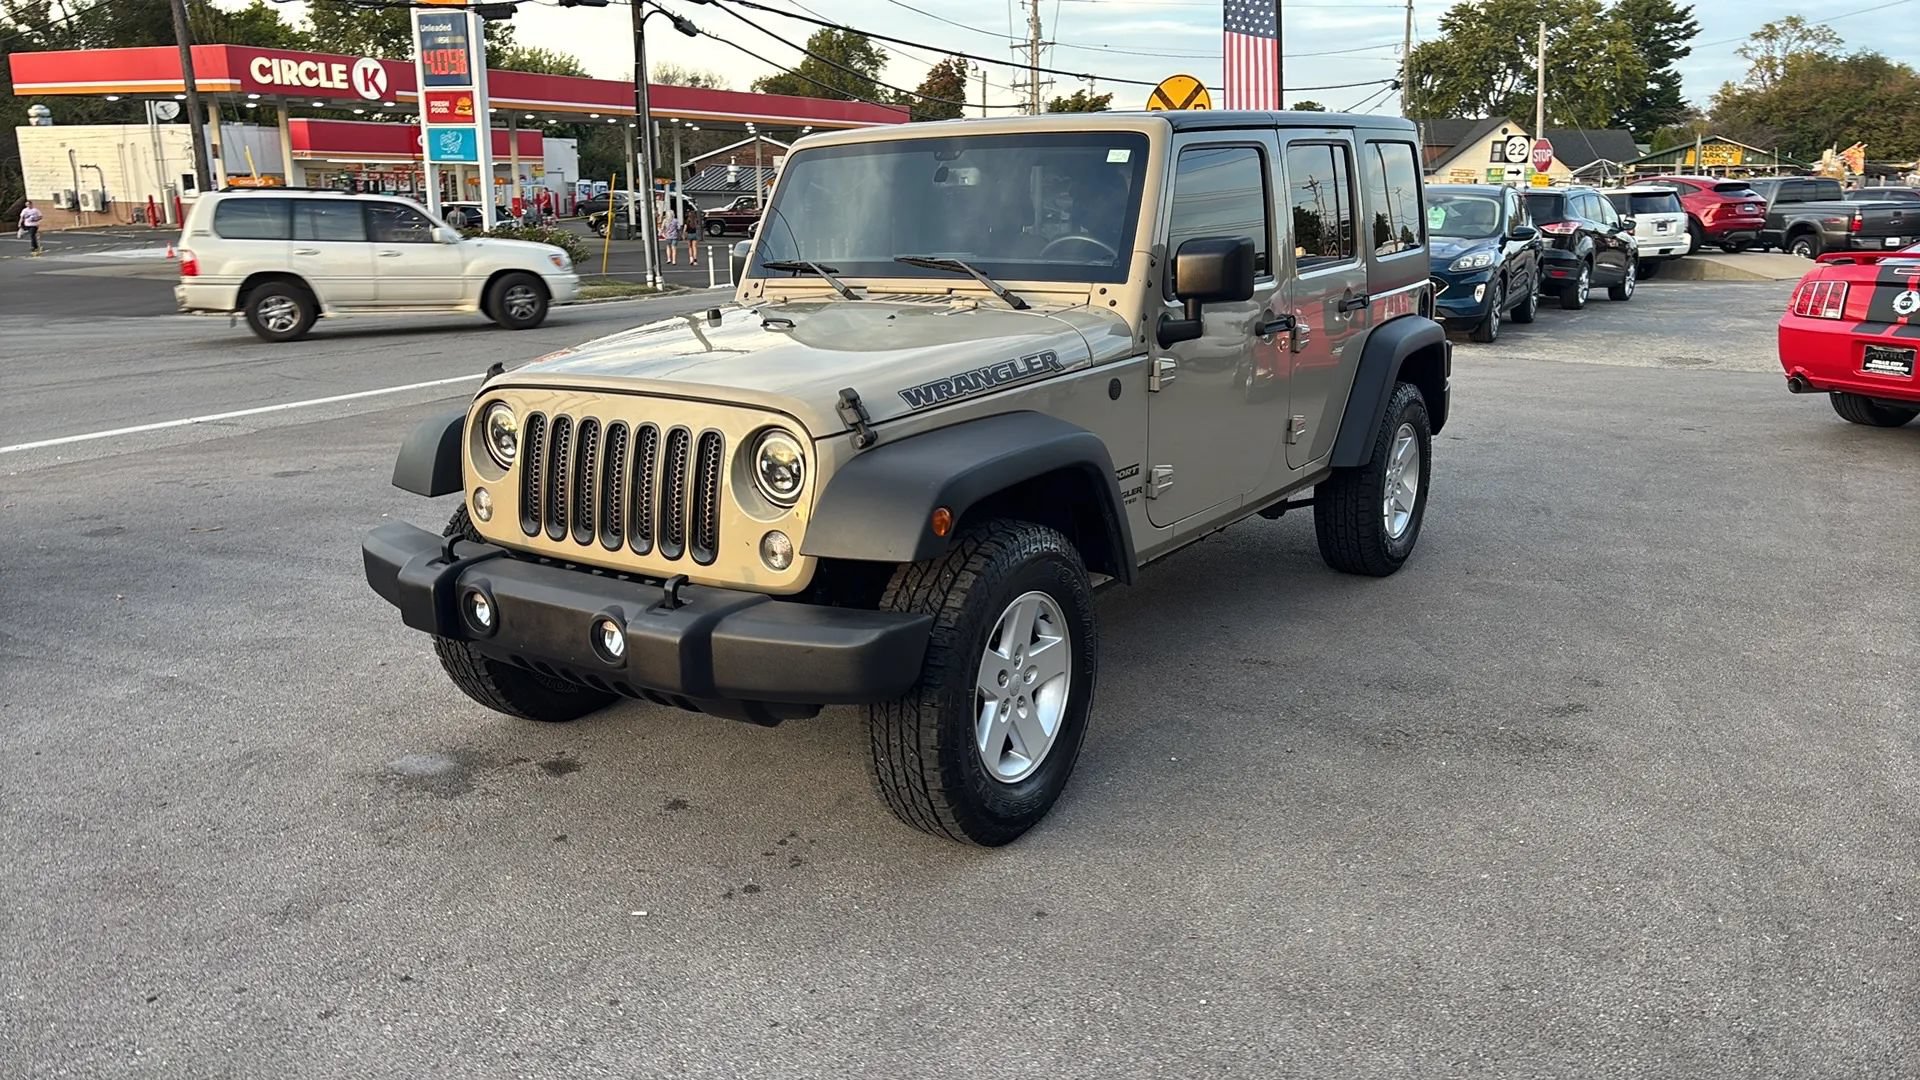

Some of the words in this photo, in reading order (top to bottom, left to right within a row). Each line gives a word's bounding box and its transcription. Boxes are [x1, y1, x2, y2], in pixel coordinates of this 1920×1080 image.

[420, 23, 452, 32] Unleaded
[250, 56, 349, 90] CIRCLE
[360, 65, 386, 99] K
[1508, 143, 1527, 156] 22
[1533, 148, 1552, 163] STOP
[897, 349, 1066, 410] WRANGLER
